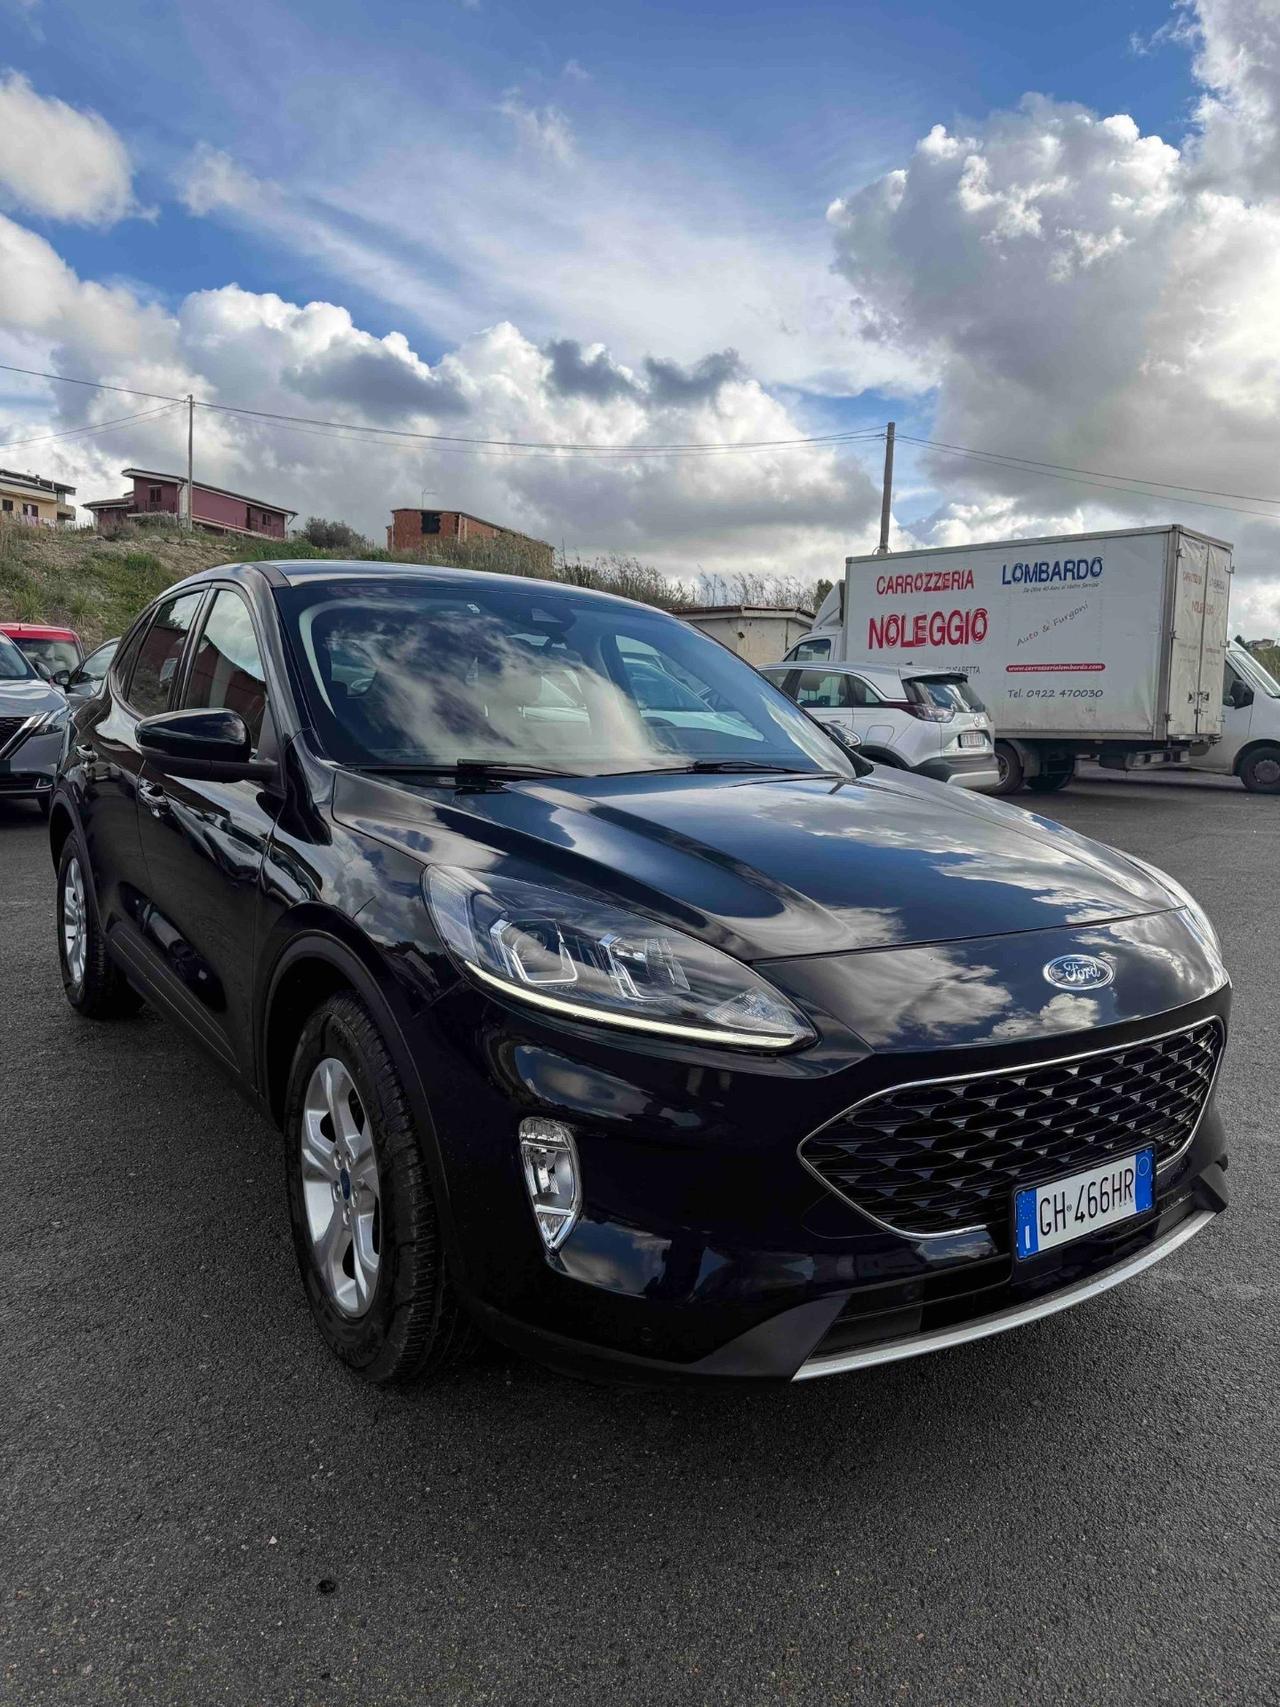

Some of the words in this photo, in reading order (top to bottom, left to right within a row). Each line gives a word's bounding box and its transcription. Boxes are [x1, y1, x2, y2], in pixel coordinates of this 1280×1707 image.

[876, 569, 975, 595] CARROZZERIA
[1002, 557, 1104, 585] LOMBARDO
[868, 607, 988, 649] NOLEGGIO
[1017, 631, 1039, 646] Auto
[1053, 600, 1088, 627] Furgoni
[1008, 689, 1023, 698] Tel.
[1026, 689, 1055, 698] 0922
[1059, 689, 1103, 698] 470030
[1063, 961, 1100, 981] Ford
